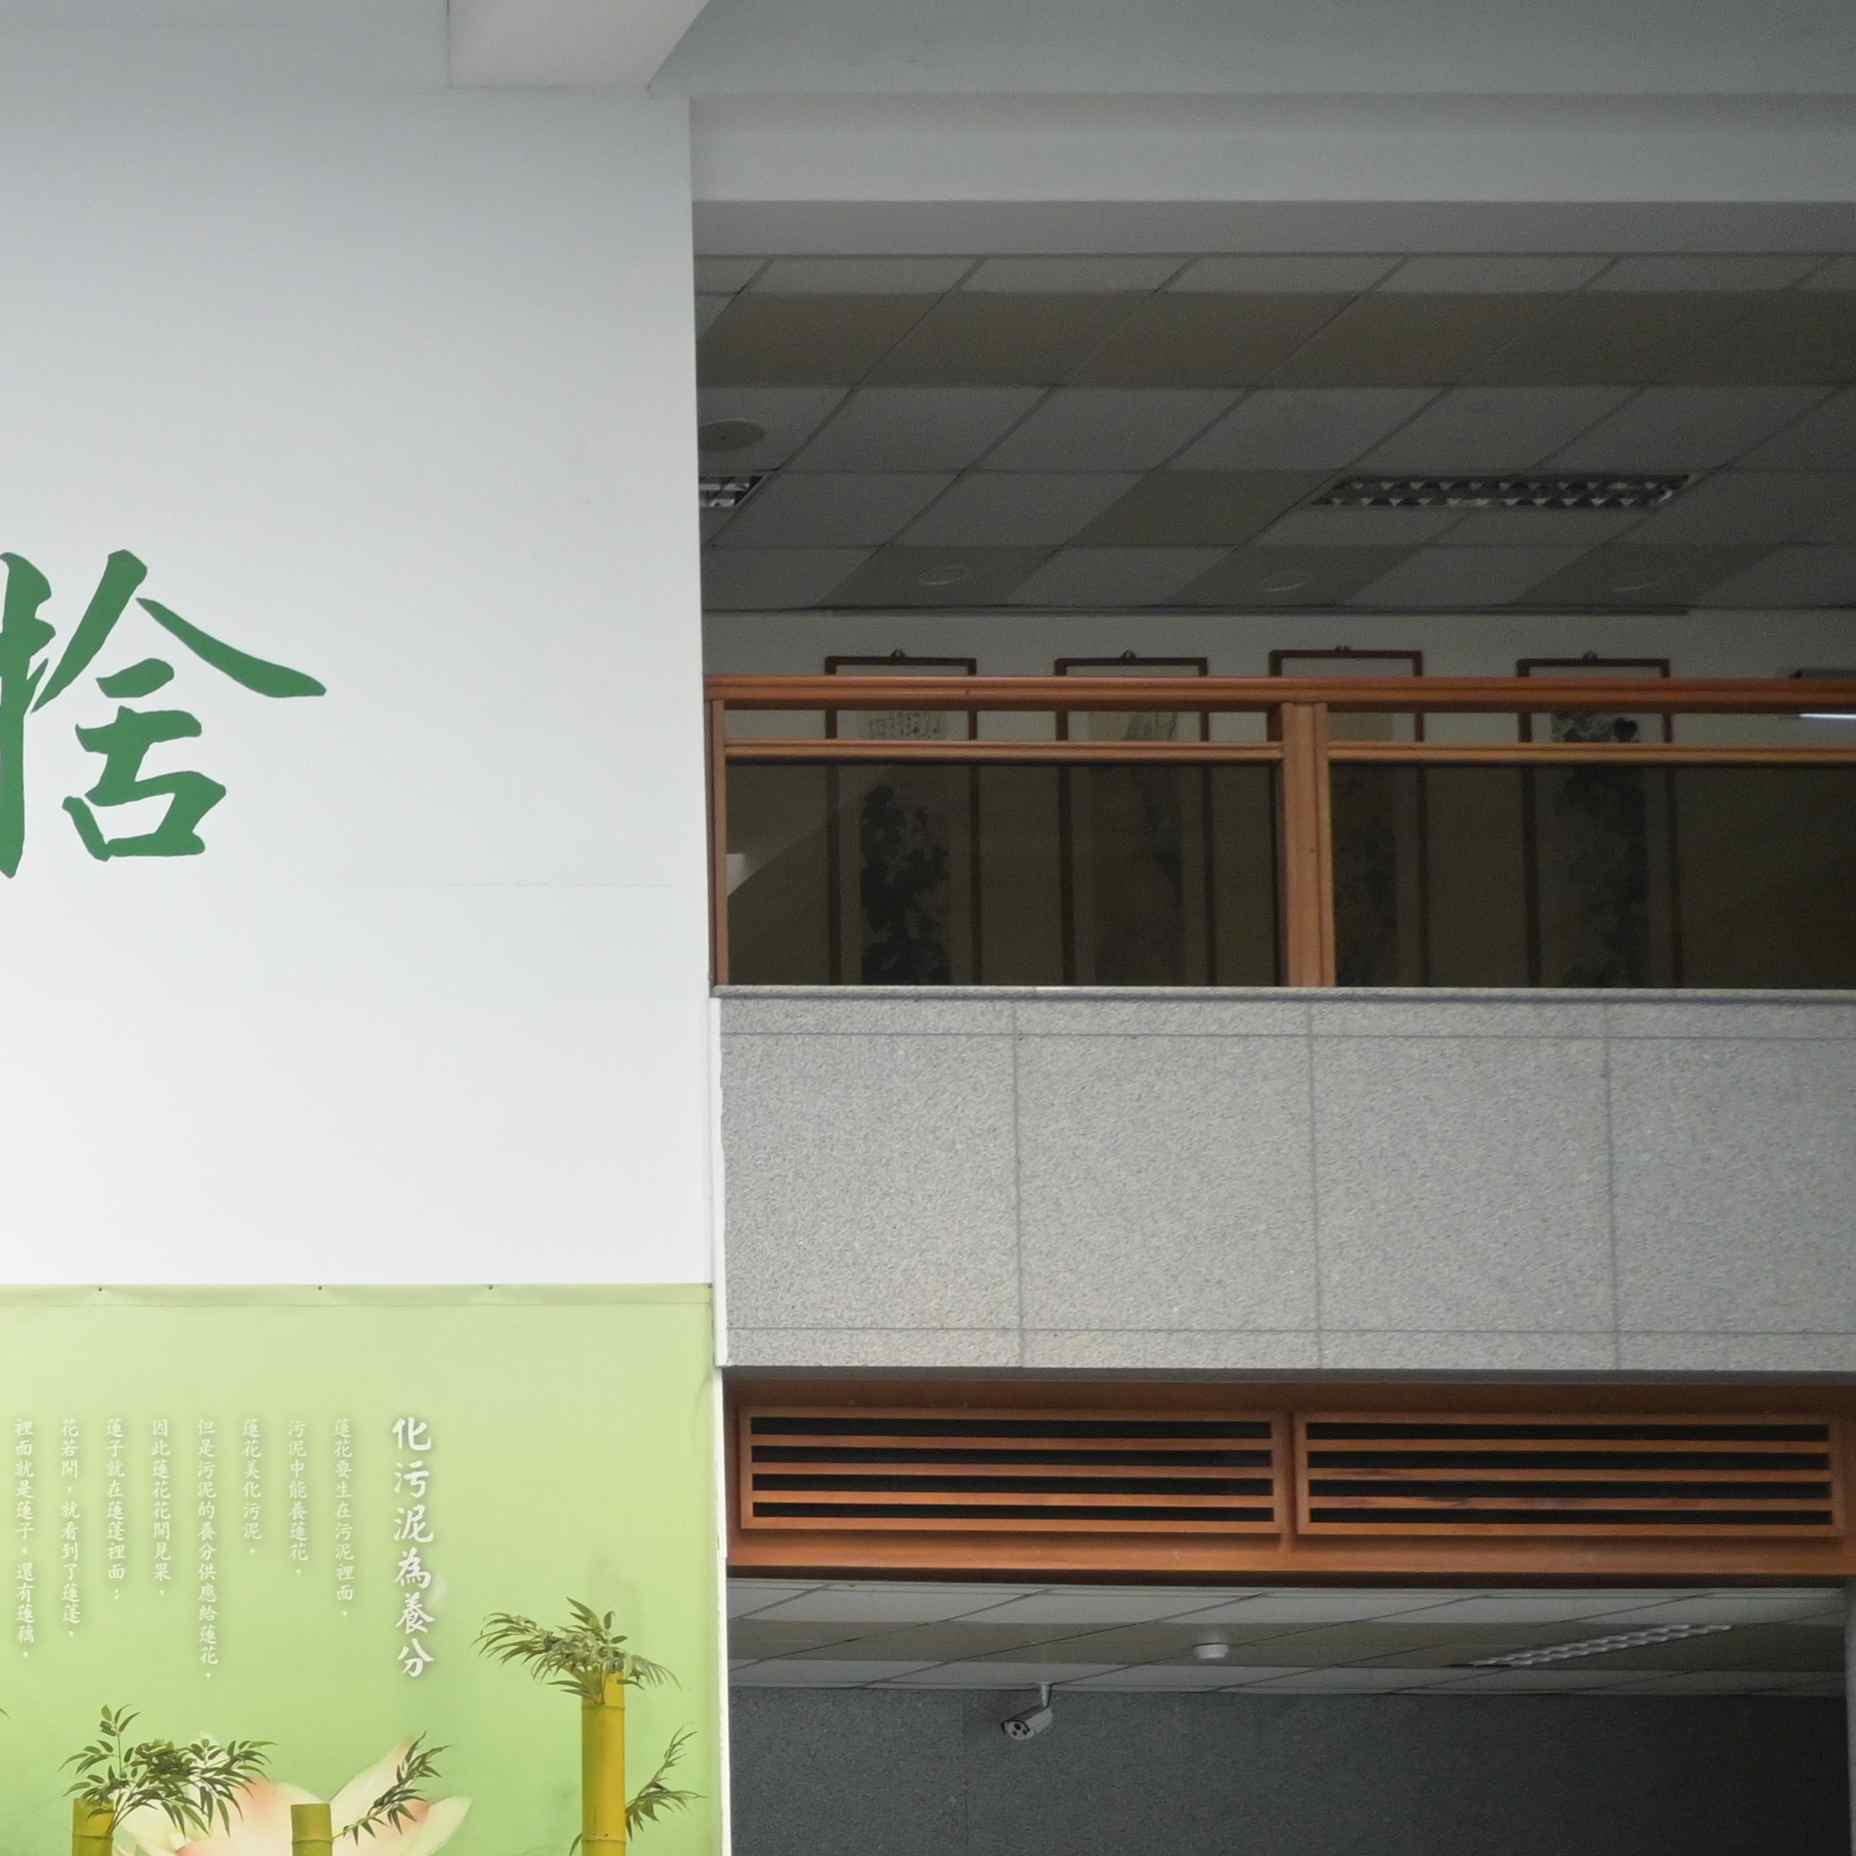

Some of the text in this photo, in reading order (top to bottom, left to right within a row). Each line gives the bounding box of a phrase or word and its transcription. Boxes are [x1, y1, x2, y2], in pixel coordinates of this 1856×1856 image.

[391, 1415, 435, 1678] 化污泥為養分
